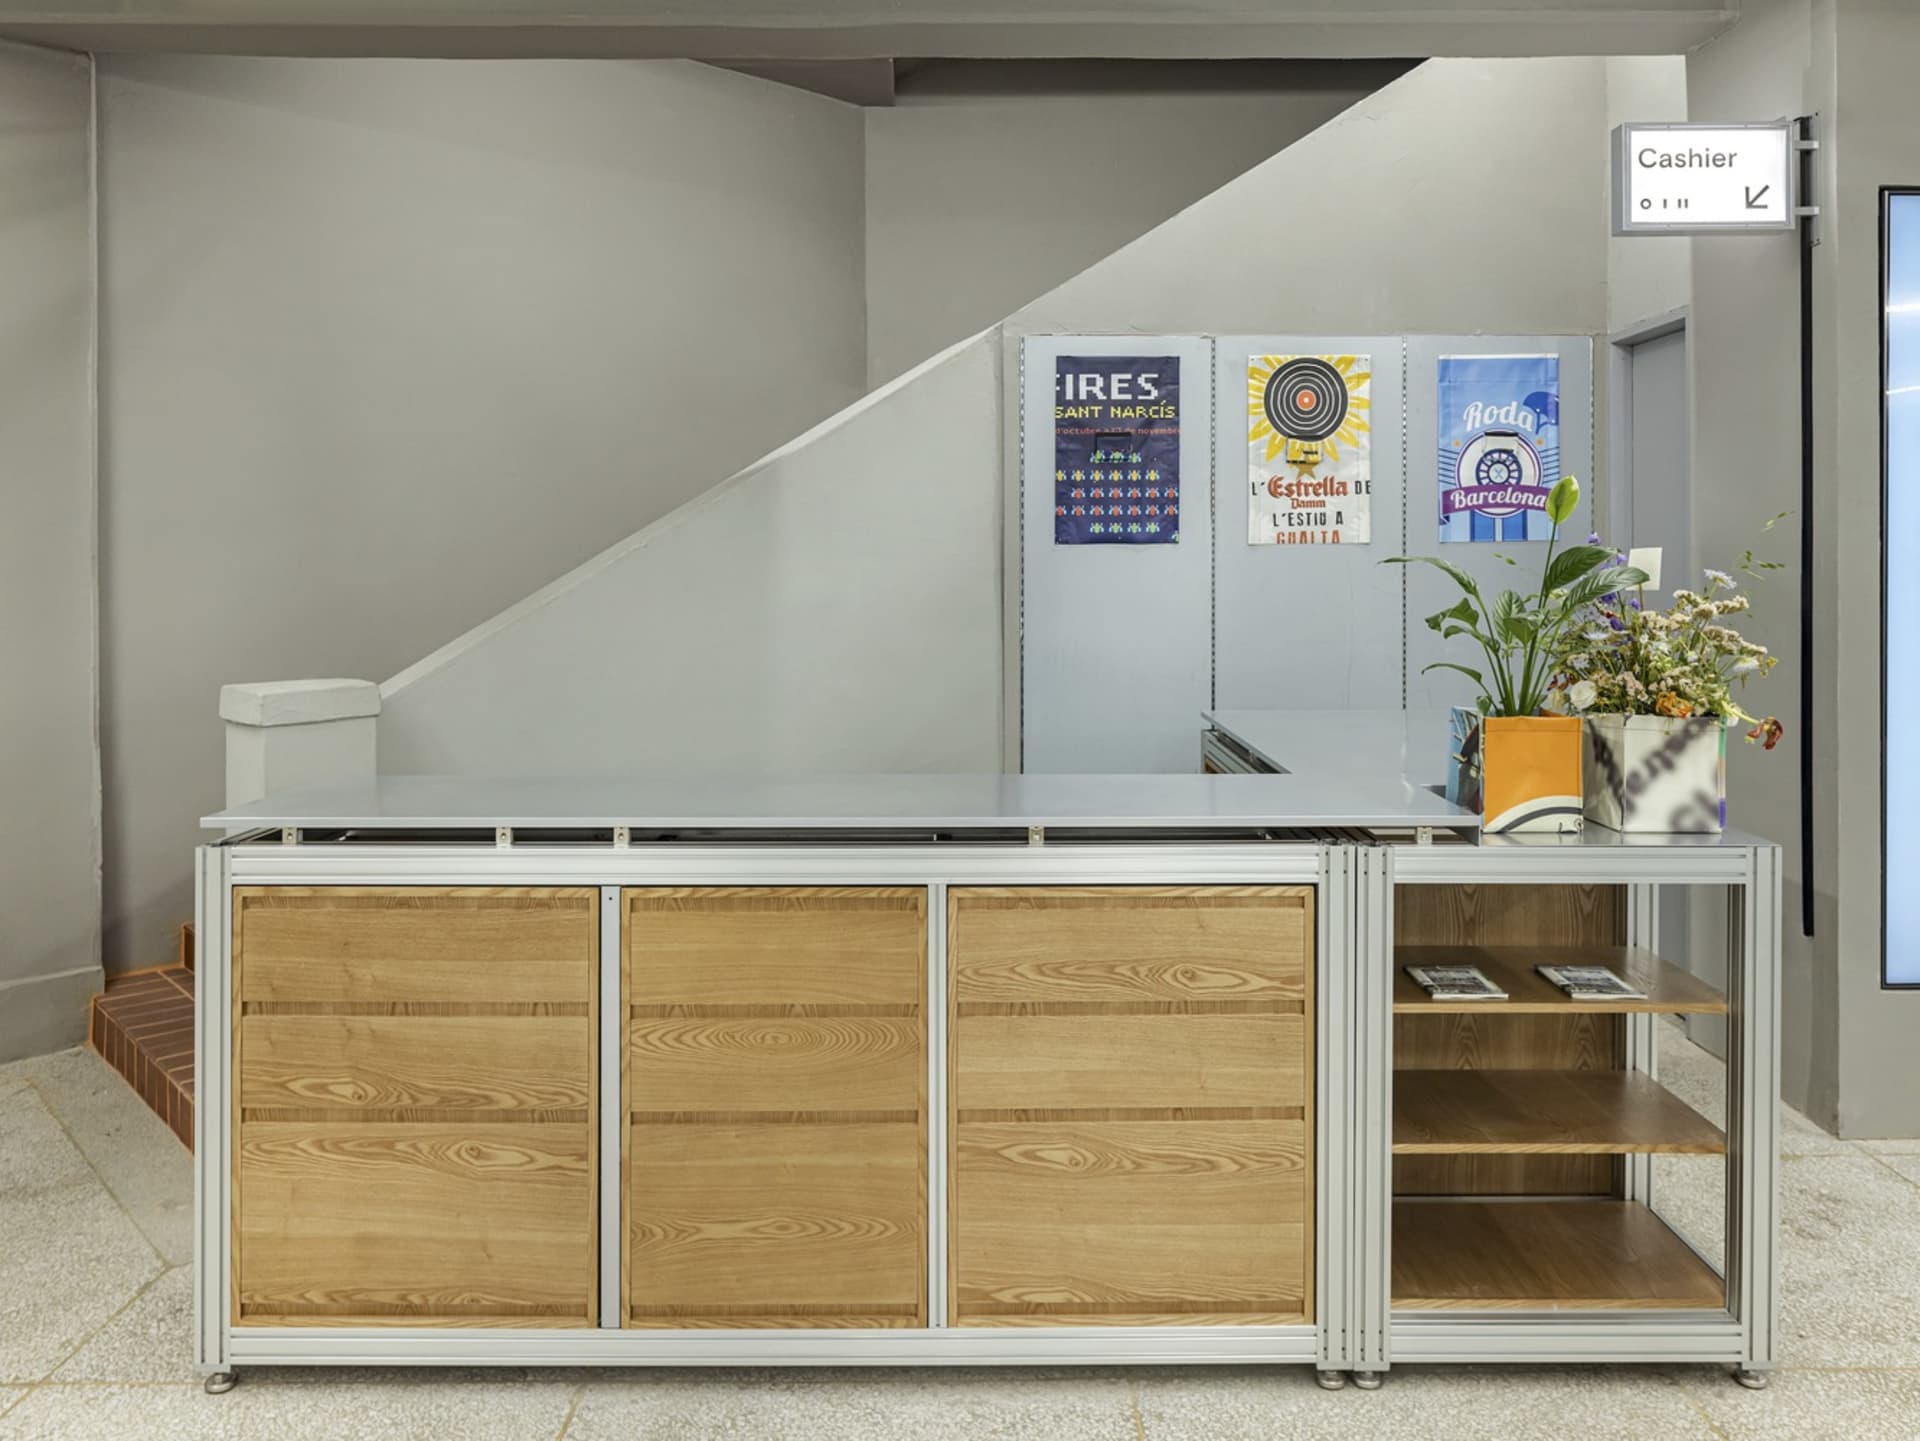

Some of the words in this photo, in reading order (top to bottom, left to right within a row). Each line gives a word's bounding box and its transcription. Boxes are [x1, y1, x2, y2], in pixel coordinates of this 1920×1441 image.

[1638, 147, 1738, 169] Cashier
[1056, 373, 1159, 400] IRES
[1055, 406, 1103, 418] SANT
[1110, 400, 1176, 419] NARCÍS
[1463, 400, 1534, 433] Roda
[1355, 480, 1372, 495] DE
[1291, 498, 1327, 510] Damm
[1450, 487, 1547, 510] Barcelona
[1273, 512, 1327, 527] L'ESTIU
[1335, 511, 1344, 525] A
